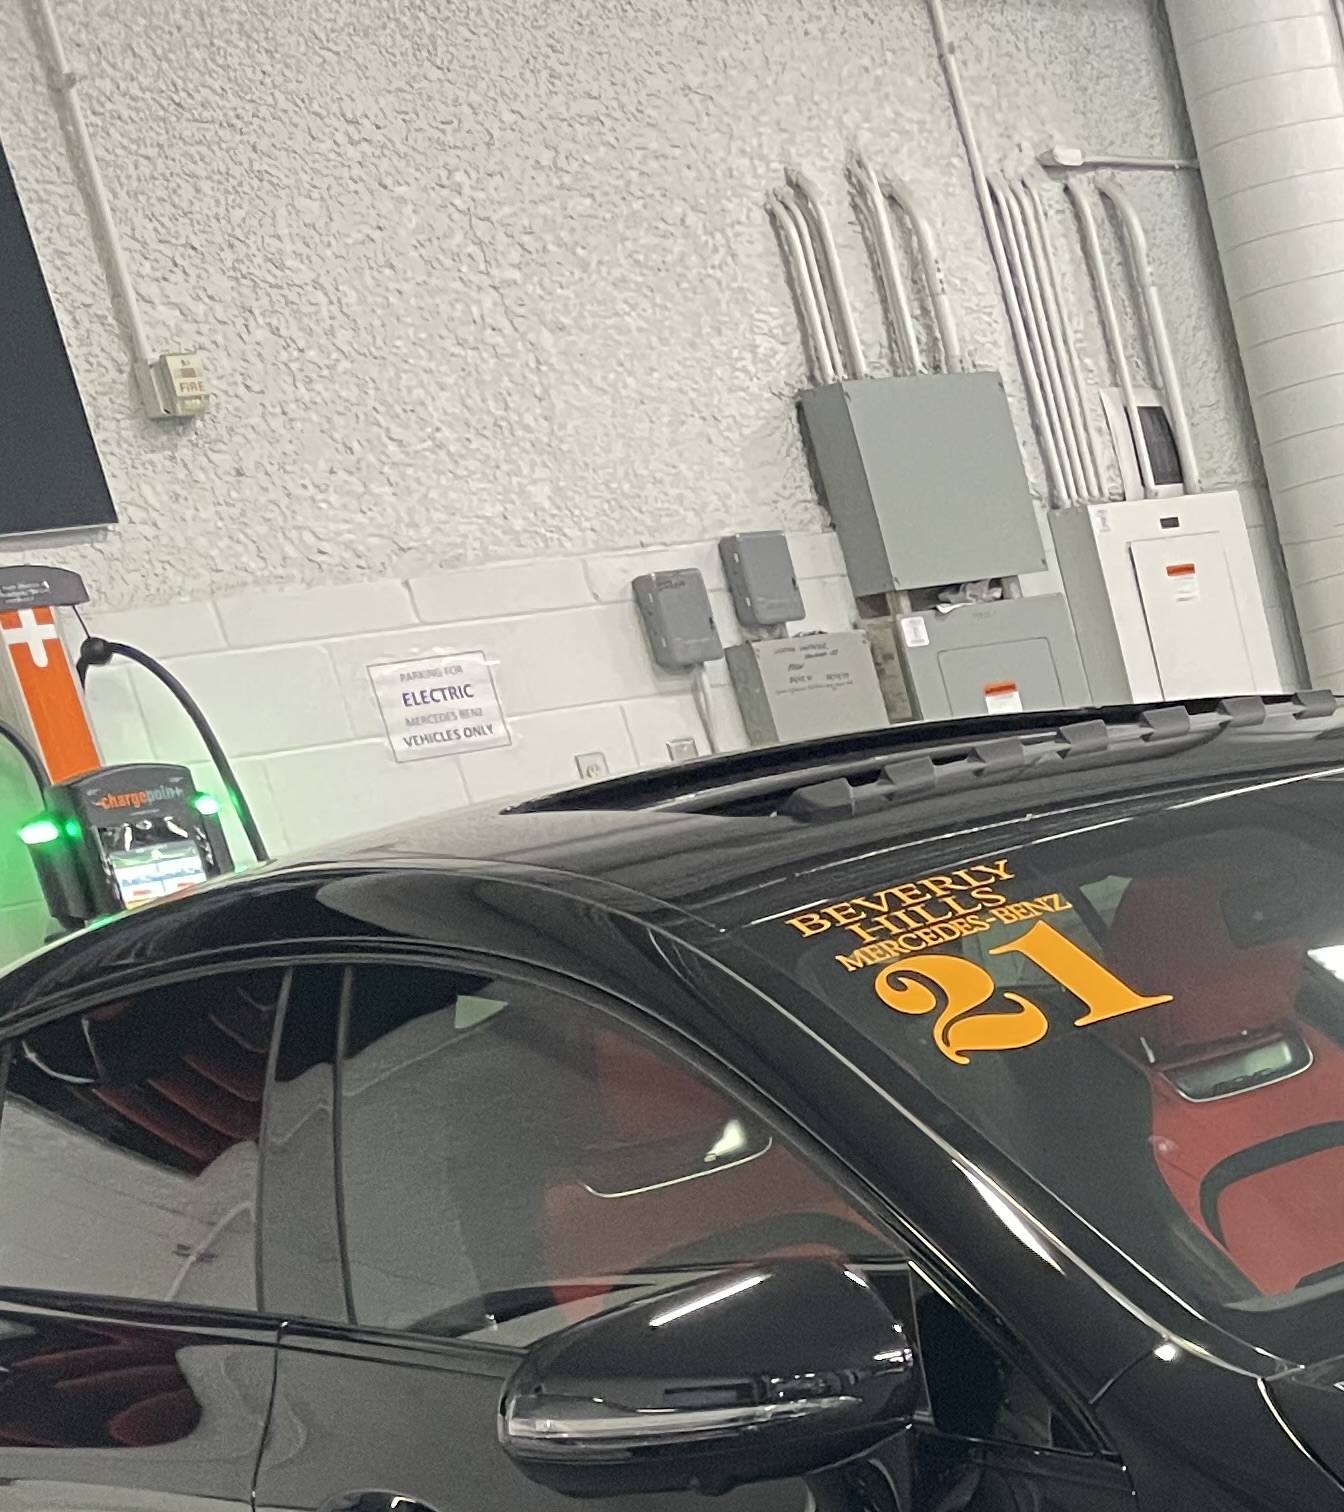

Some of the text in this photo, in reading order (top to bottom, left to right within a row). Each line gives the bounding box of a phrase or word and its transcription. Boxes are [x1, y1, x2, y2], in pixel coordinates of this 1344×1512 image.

[179, 381, 203, 393] FIRE
[399, 664, 464, 683] PARKING FOR
[402, 683, 475, 707] ELECTRIC
[404, 707, 484, 727] MERCEDES BENZ
[402, 723, 494, 747] VEHICLES ONLY
[784, 858, 1015, 939] BEVERLY
[844, 886, 1008, 946] HILLS
[834, 892, 1074, 973] MERCEDES-BENZ
[873, 919, 1175, 1066] 21
